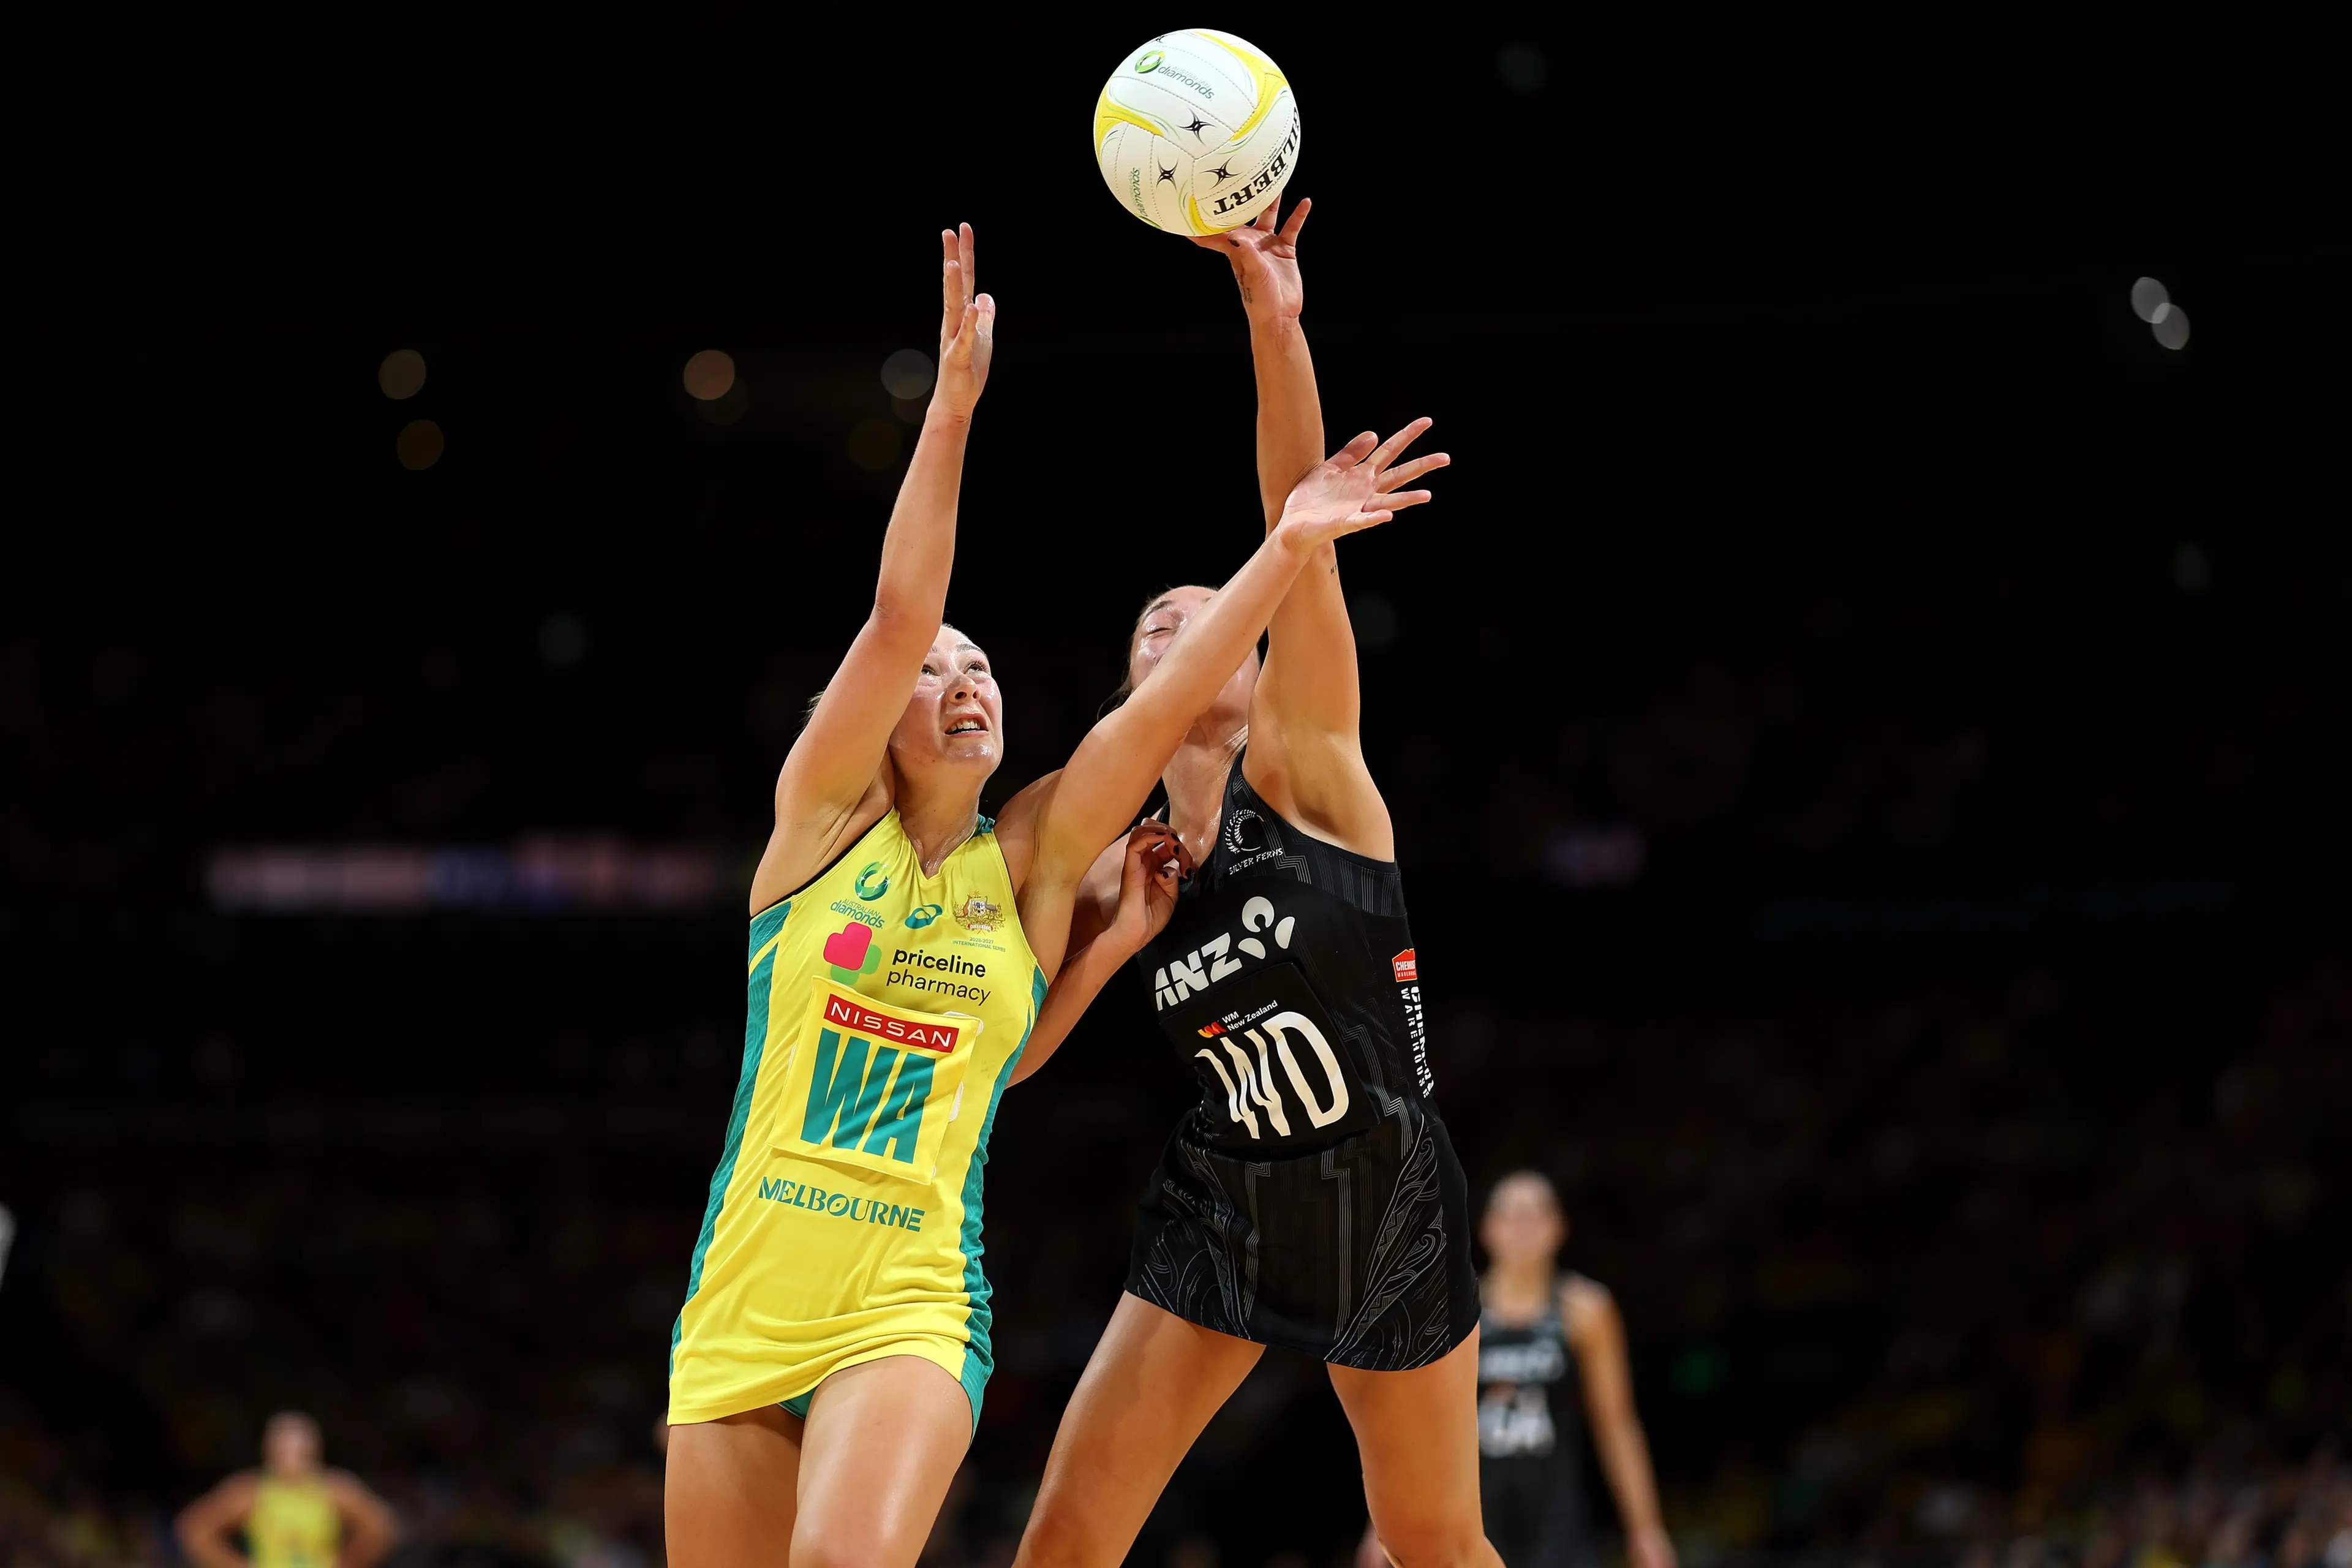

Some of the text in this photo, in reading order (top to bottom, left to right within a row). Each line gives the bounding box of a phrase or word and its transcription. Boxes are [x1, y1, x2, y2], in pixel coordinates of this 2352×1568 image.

[1158, 66, 1215, 99] diamonds
[1213, 107, 1299, 216] GILBERT
[1229, 848, 1283, 875] SILVER FERNS
[831, 900, 884, 929] diamonds
[842, 899, 880, 917] AUSTRALIAN
[952, 940, 992, 949] INTERNATIONAL
[892, 949, 986, 978] priceline
[1155, 932, 1242, 1011] ANZ
[886, 969, 991, 1006] pharmacy
[831, 1001, 952, 1048] NISSAN
[1222, 1011, 1239, 1023] WM
[1227, 1000, 1278, 1031] New Zealand
[1401, 987, 1430, 1098] WAREHOUSE
[1194, 1011, 1349, 1139] WD
[800, 1027, 936, 1164] WA
[758, 1176, 925, 1232] MELBOURNE
